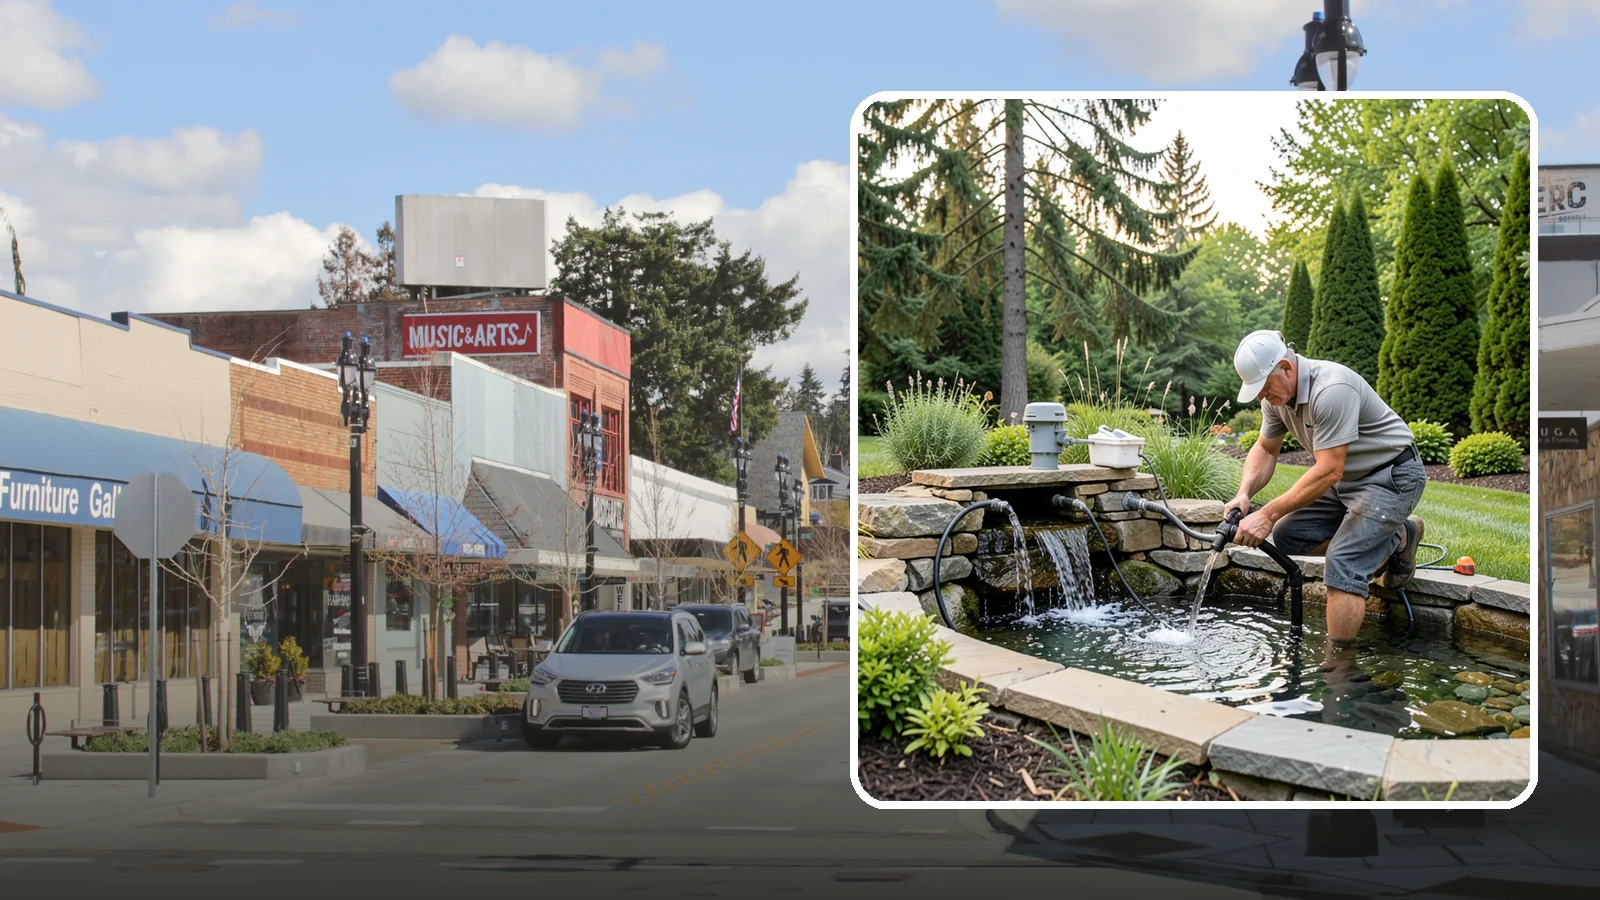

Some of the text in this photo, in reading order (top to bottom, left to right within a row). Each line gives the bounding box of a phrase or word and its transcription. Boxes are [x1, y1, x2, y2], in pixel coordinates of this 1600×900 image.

[409, 323, 519, 348] MUSIC&ARTS
[0, 472, 122, 519] Furniture Gal
[453, 564, 479, 574] SUSHI
